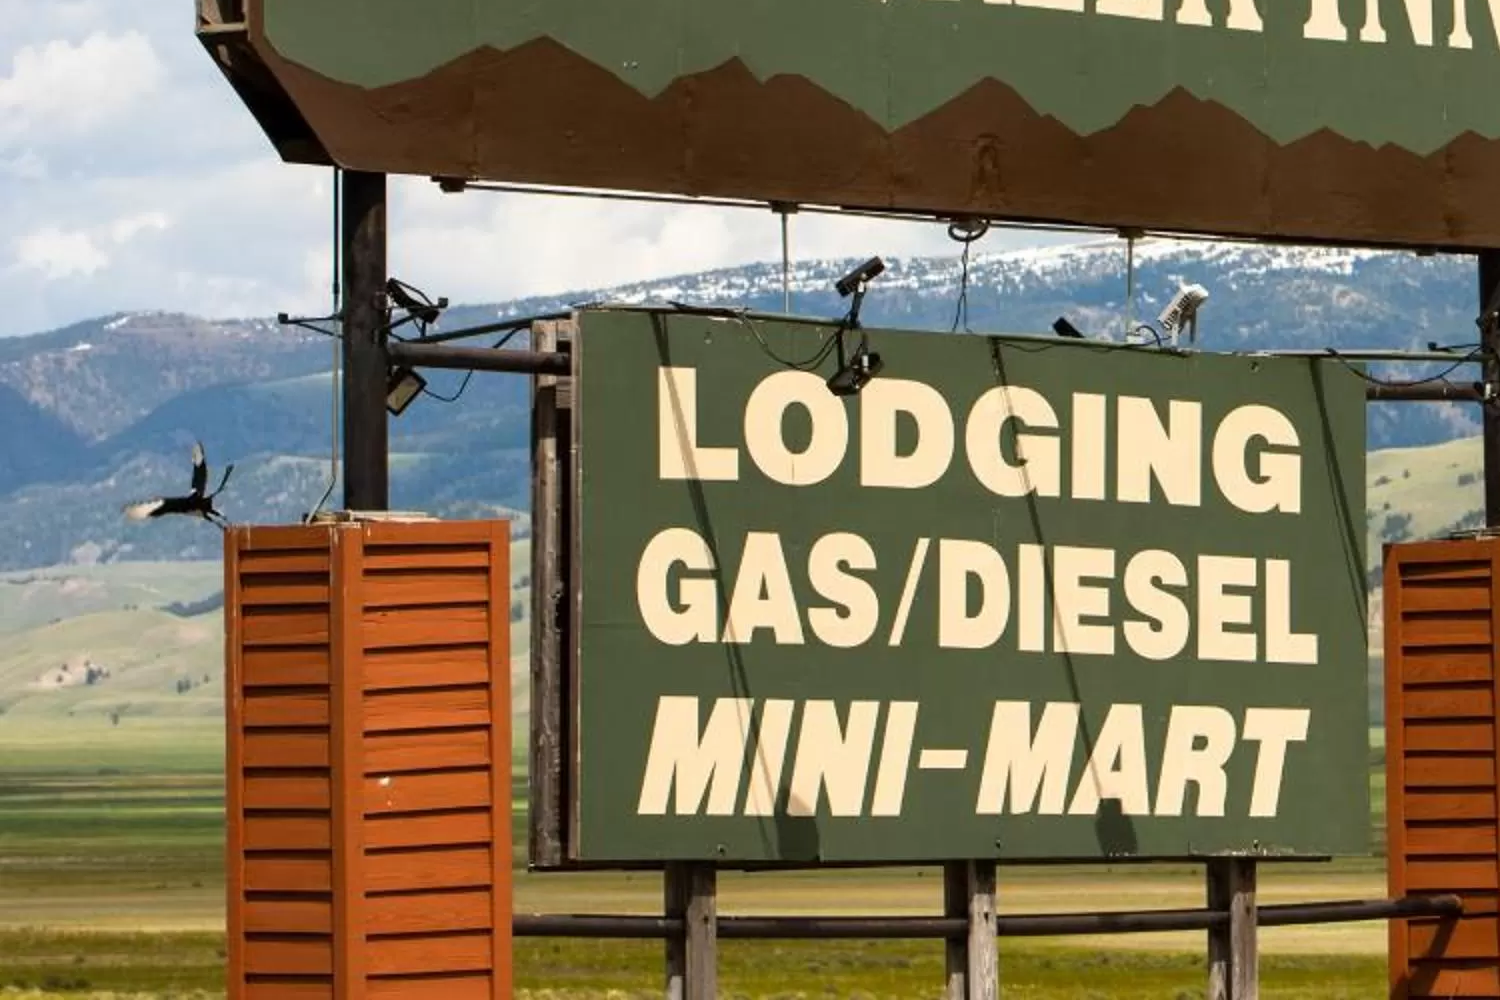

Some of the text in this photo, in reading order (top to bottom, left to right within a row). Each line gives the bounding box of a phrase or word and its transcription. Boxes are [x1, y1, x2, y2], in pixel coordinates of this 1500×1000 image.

[657, 366, 1302, 514] LODGING
[636, 527, 1319, 665] GAS/DIESEL
[637, 695, 1311, 817] MINI-MART
